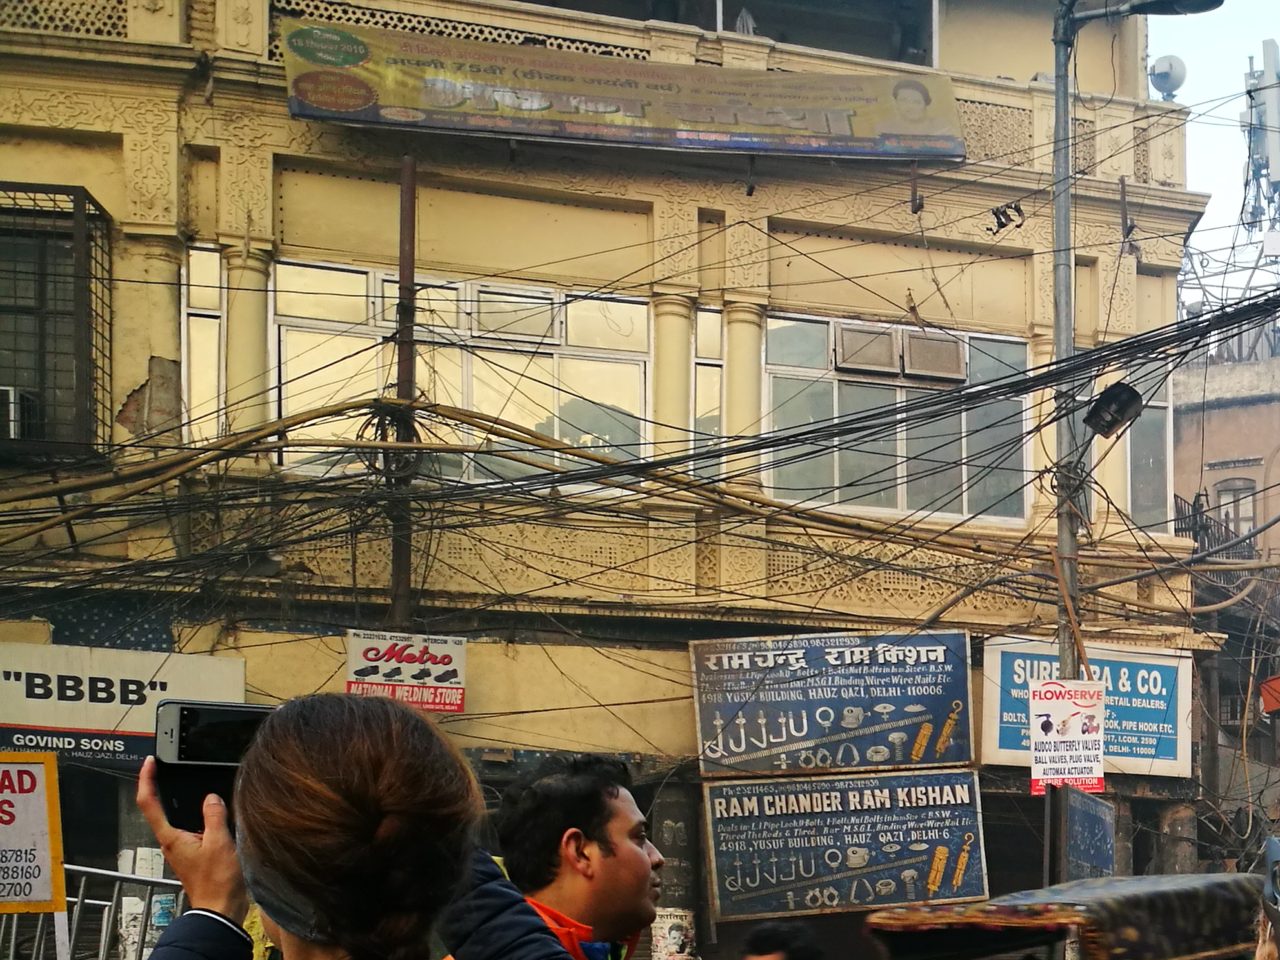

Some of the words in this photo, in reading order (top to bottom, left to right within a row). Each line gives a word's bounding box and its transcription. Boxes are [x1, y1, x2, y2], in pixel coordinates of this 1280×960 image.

[362, 642, 453, 666] Metro
[875, 643, 947, 665] किशन
[3, 670, 168, 706] "BBBB"
[1118, 667, 1132, 693] &
[1136, 669, 1167, 696] CO.
[395, 686, 435, 703] WELDING
[435, 688, 463, 705] STORE
[808, 687, 838, 699] HAUZ
[841, 686, 868, 699] QAZI,
[1032, 689, 1103, 701] FLOWSERVE
[1132, 698, 1168, 710] DEALERS:
[1003, 711, 1028, 724] BOLTS,
[1122, 720, 1137, 731] PIPE
[1138, 722, 1158, 733] HOOK
[1159, 724, 1175, 734] ETC.
[13, 734, 76, 750] GOVIND
[80, 738, 125, 752] SONS
[1053, 740, 1081, 752] BUTTERFLY
[1082, 739, 1101, 751] VALVES
[1034, 756, 1048, 765] BALL
[1069, 754, 1082, 764] PLUG
[1067, 766, 1094, 776] ACTUATOR
[1064, 777, 1098, 786] SOLUTION
[714, 796, 759, 818] RAM
[762, 792, 843, 816] CHANDER
[848, 788, 892, 811] RAM
[896, 784, 970, 808] KISHAN
[719, 840, 747, 852] 4918
[844, 833, 872, 845] HAUZ
